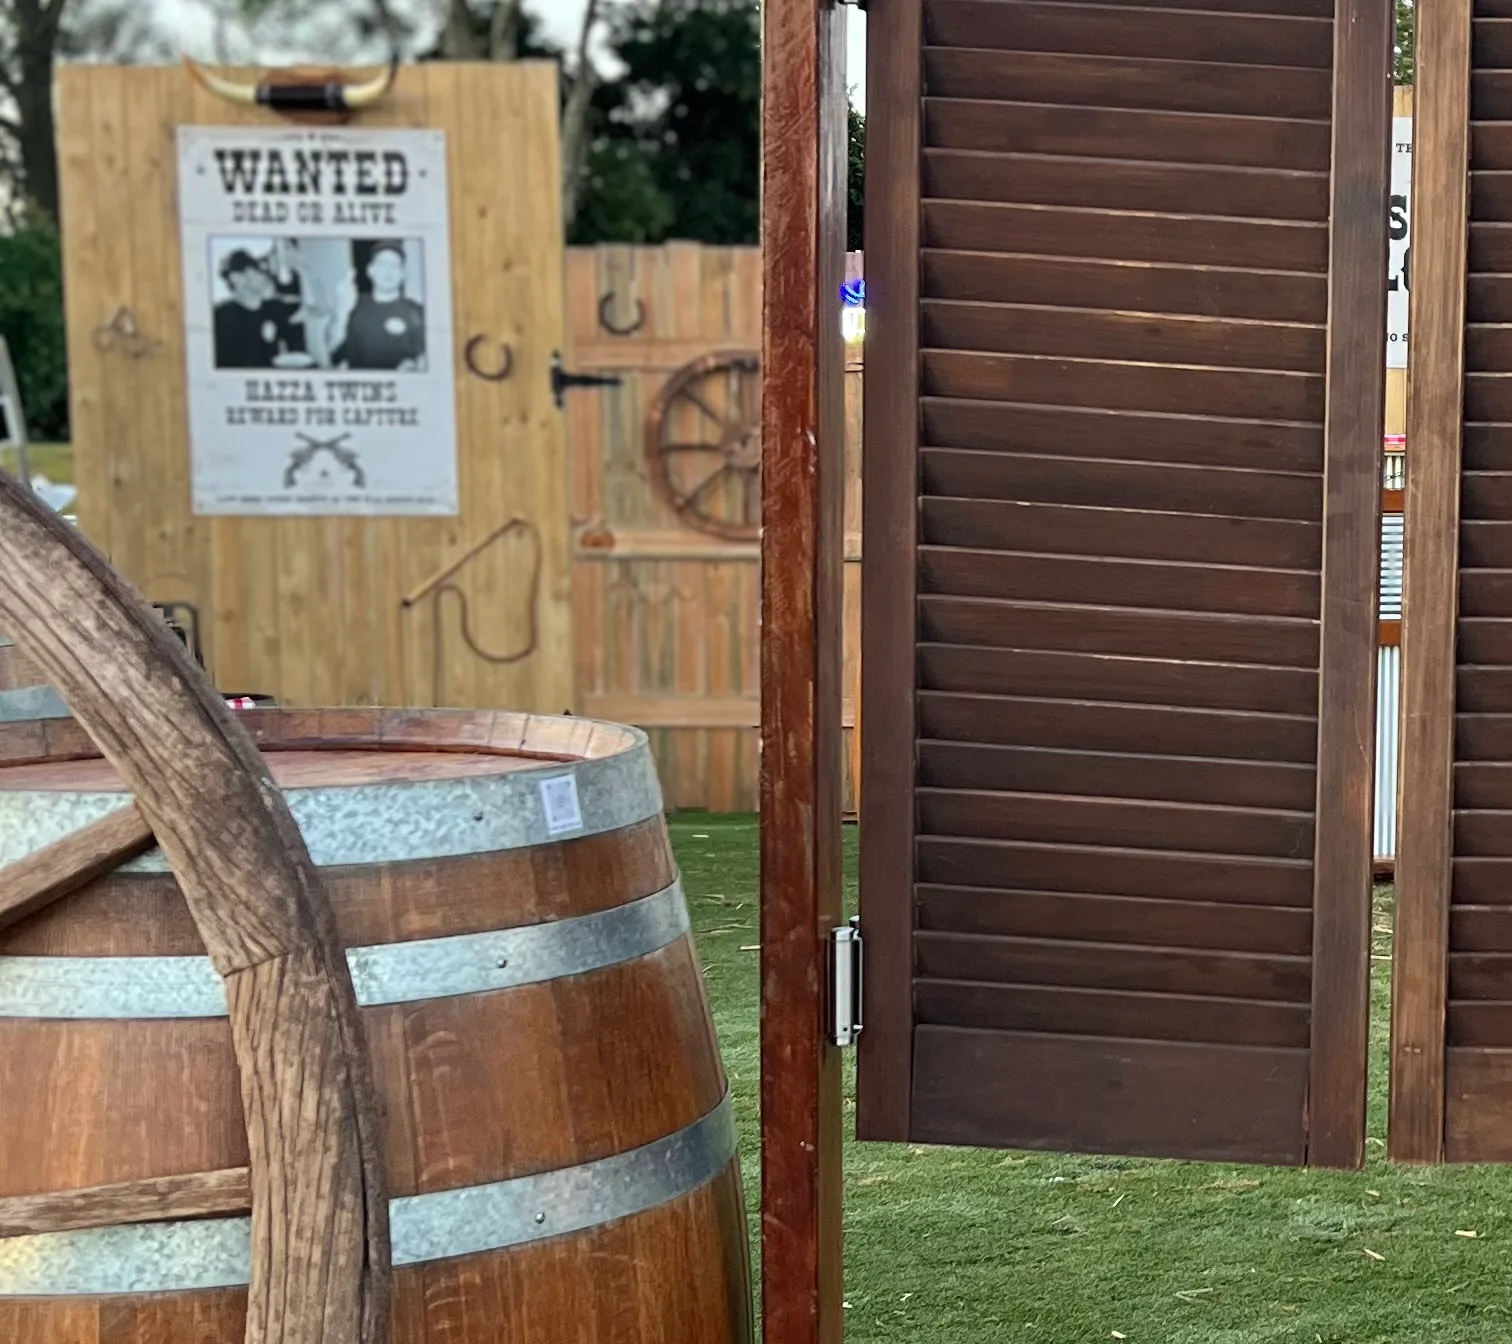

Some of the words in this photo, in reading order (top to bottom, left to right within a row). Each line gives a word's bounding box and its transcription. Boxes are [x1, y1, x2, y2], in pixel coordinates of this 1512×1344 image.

[213, 148, 410, 196] WANTED
[232, 200, 290, 224] DEAD
[297, 201, 324, 224] OR
[333, 202, 398, 225] ALIVE
[226, 407, 299, 425] REWARD
[305, 408, 336, 425] FOR
[342, 408, 419, 426] CAPTURE
